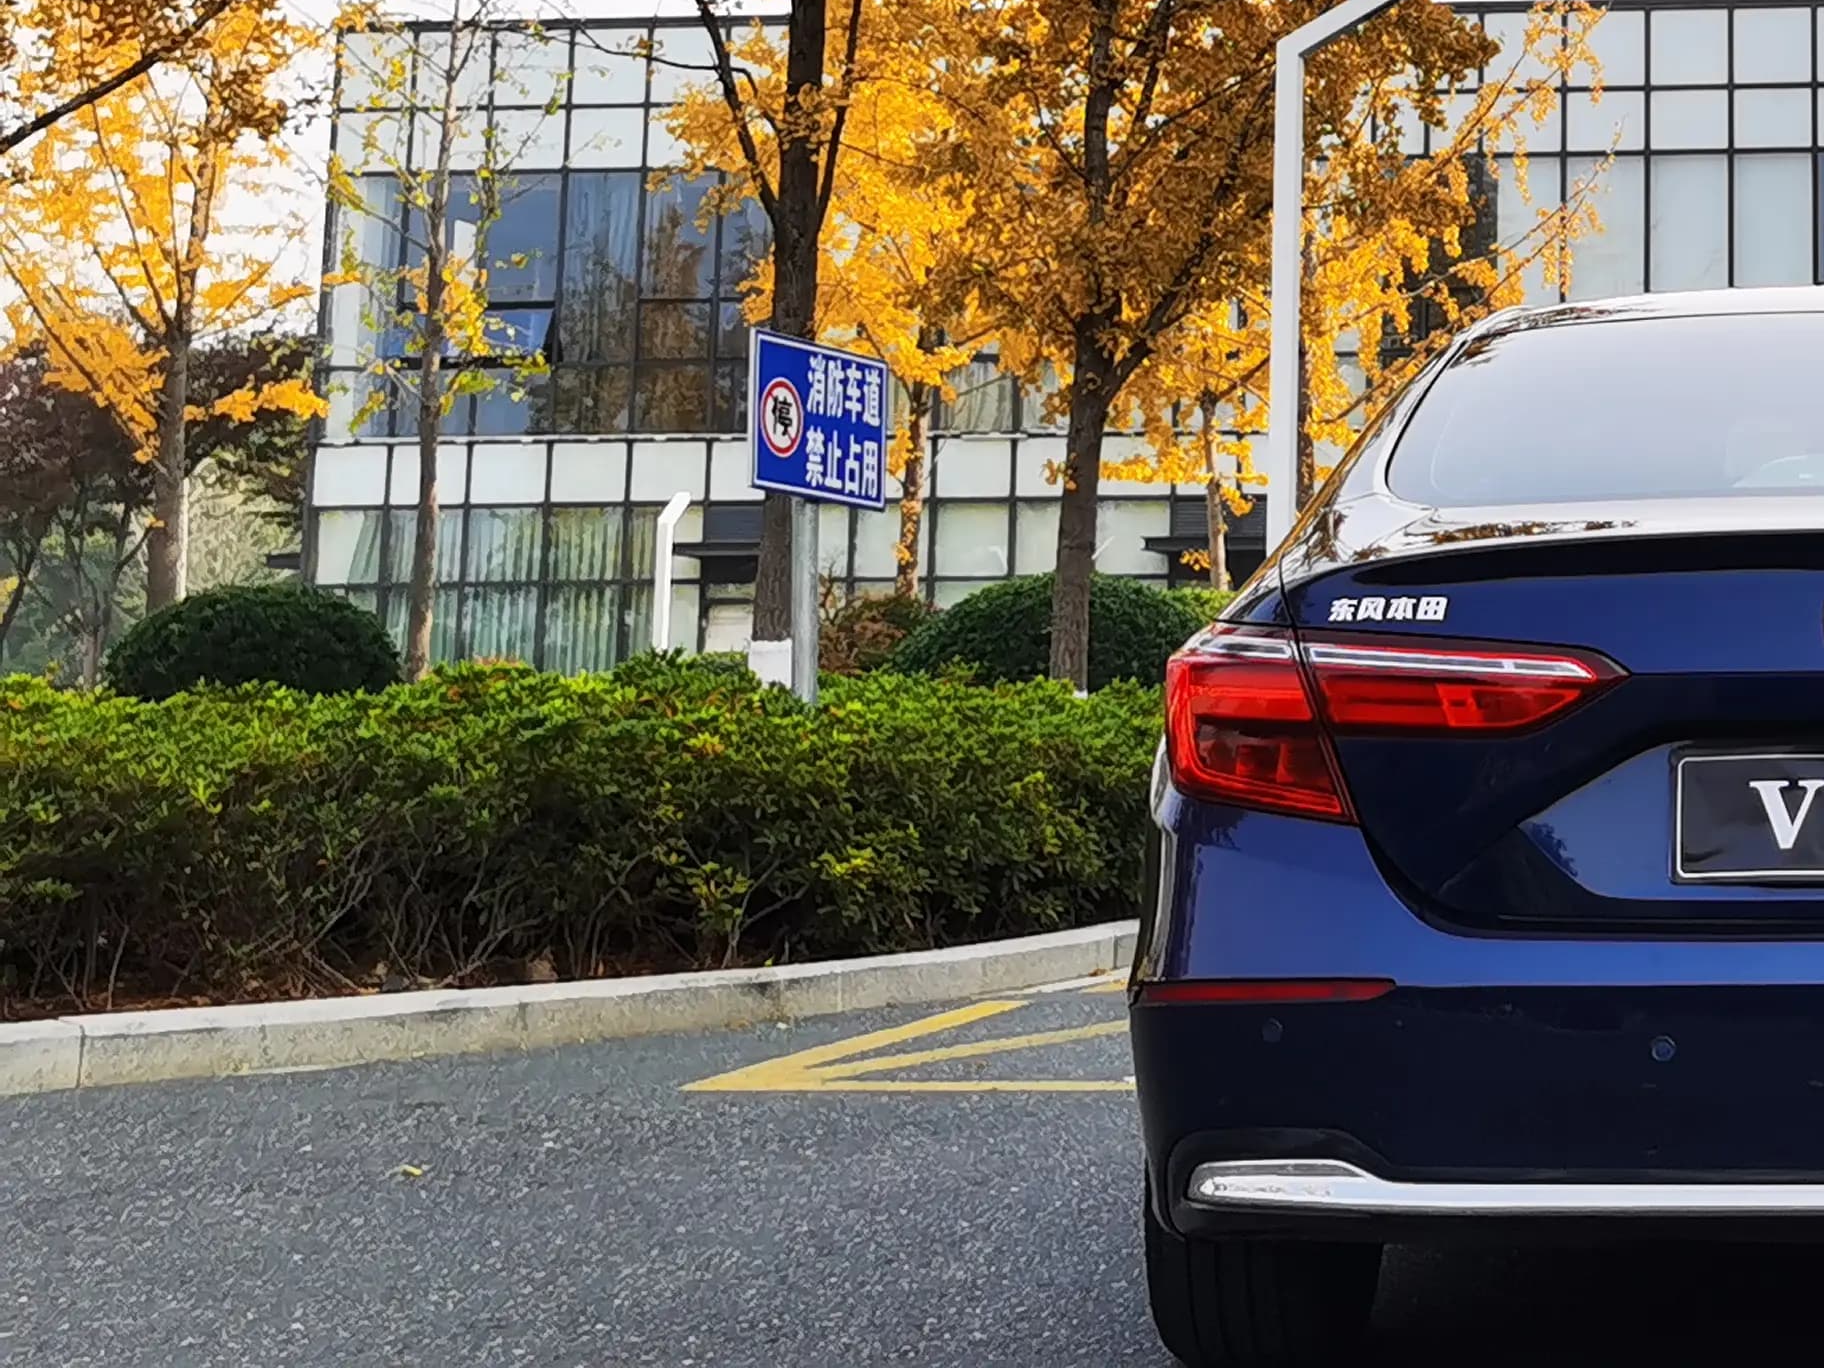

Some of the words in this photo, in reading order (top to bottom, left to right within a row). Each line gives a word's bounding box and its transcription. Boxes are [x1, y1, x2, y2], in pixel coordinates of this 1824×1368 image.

[806, 353, 881, 428] 消防车道
[804, 425, 879, 499] 禁止占用
[1328, 596, 1448, 622] 东风本田
